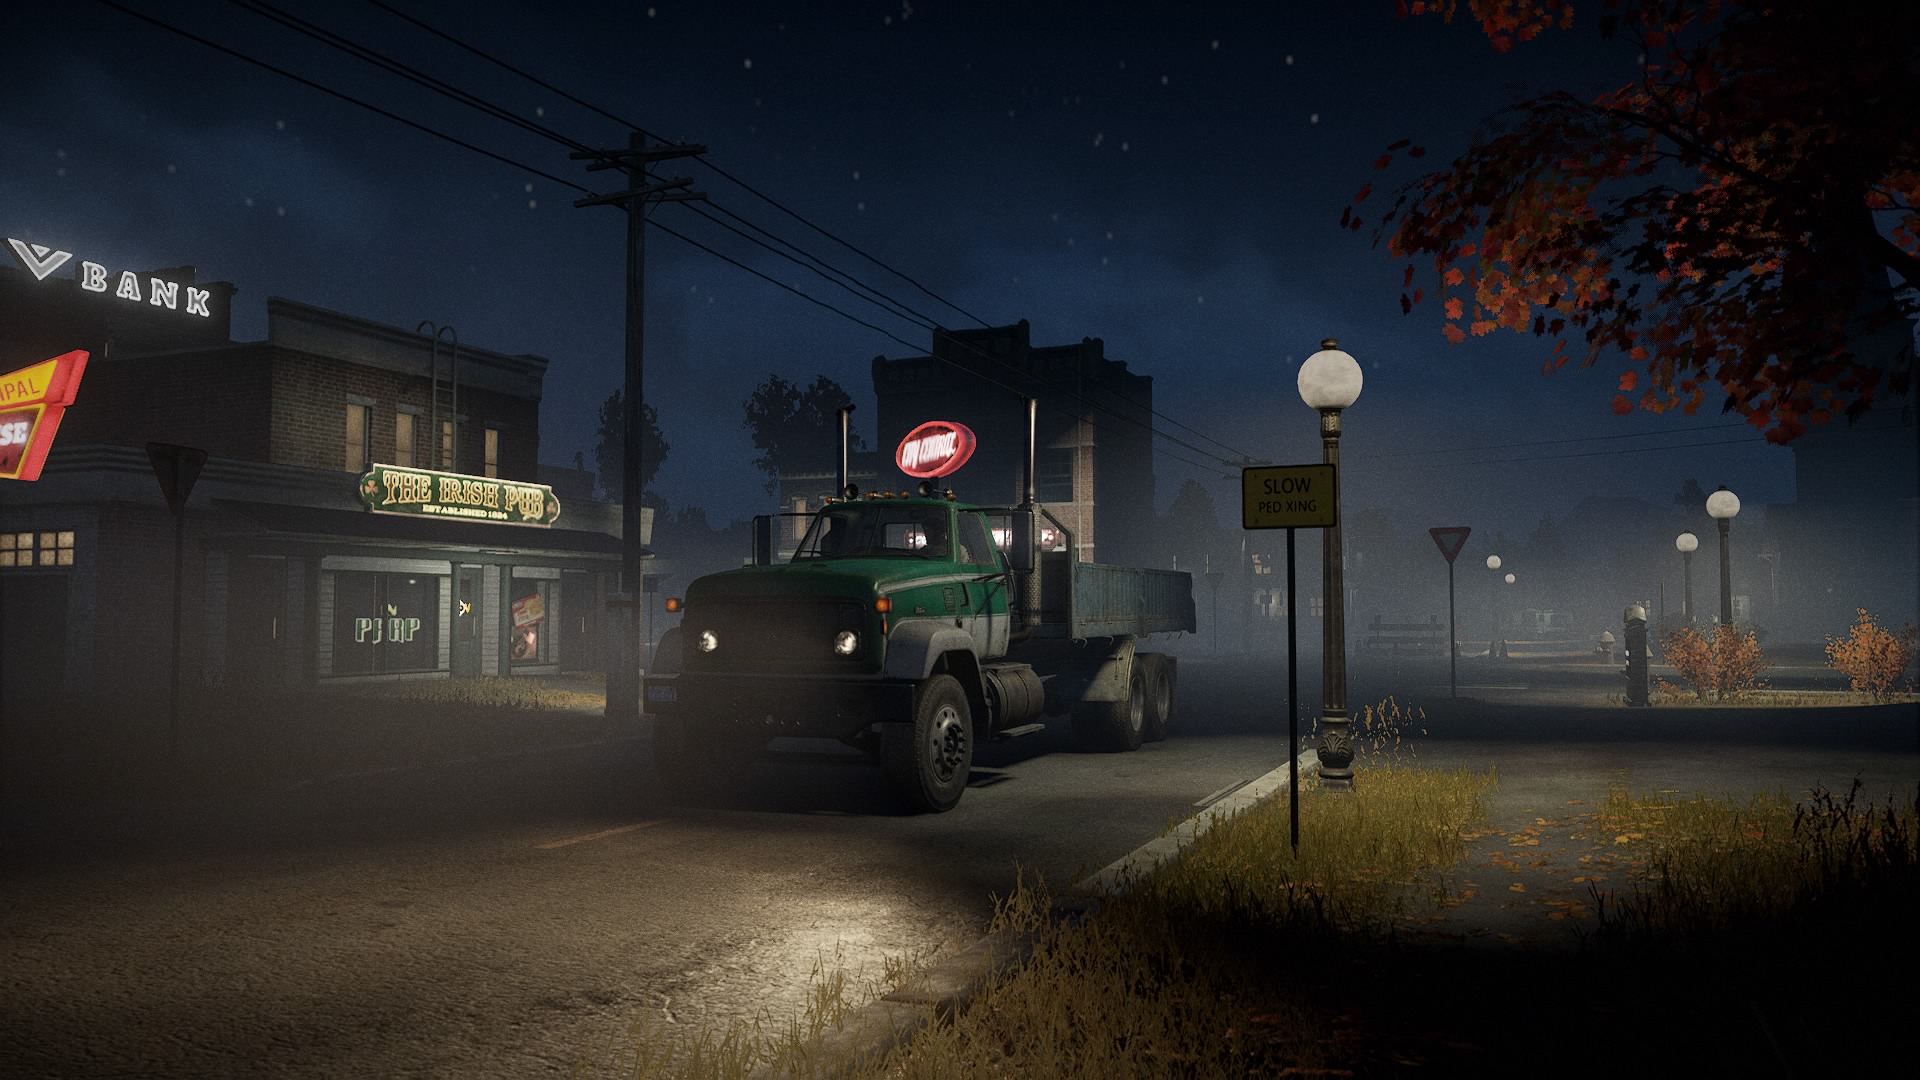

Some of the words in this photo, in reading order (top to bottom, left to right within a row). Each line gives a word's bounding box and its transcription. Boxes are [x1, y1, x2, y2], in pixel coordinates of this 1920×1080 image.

[82, 261, 210, 317] BANK
[1263, 477, 1311, 495] SLOW
[382, 470, 432, 505] THE
[439, 477, 499, 508] IRISH
[503, 485, 545, 521] PUB
[422, 504, 487, 518] ESTABLISHED
[1258, 501, 1282, 513] PED
[1286, 500, 1316, 512] XING
